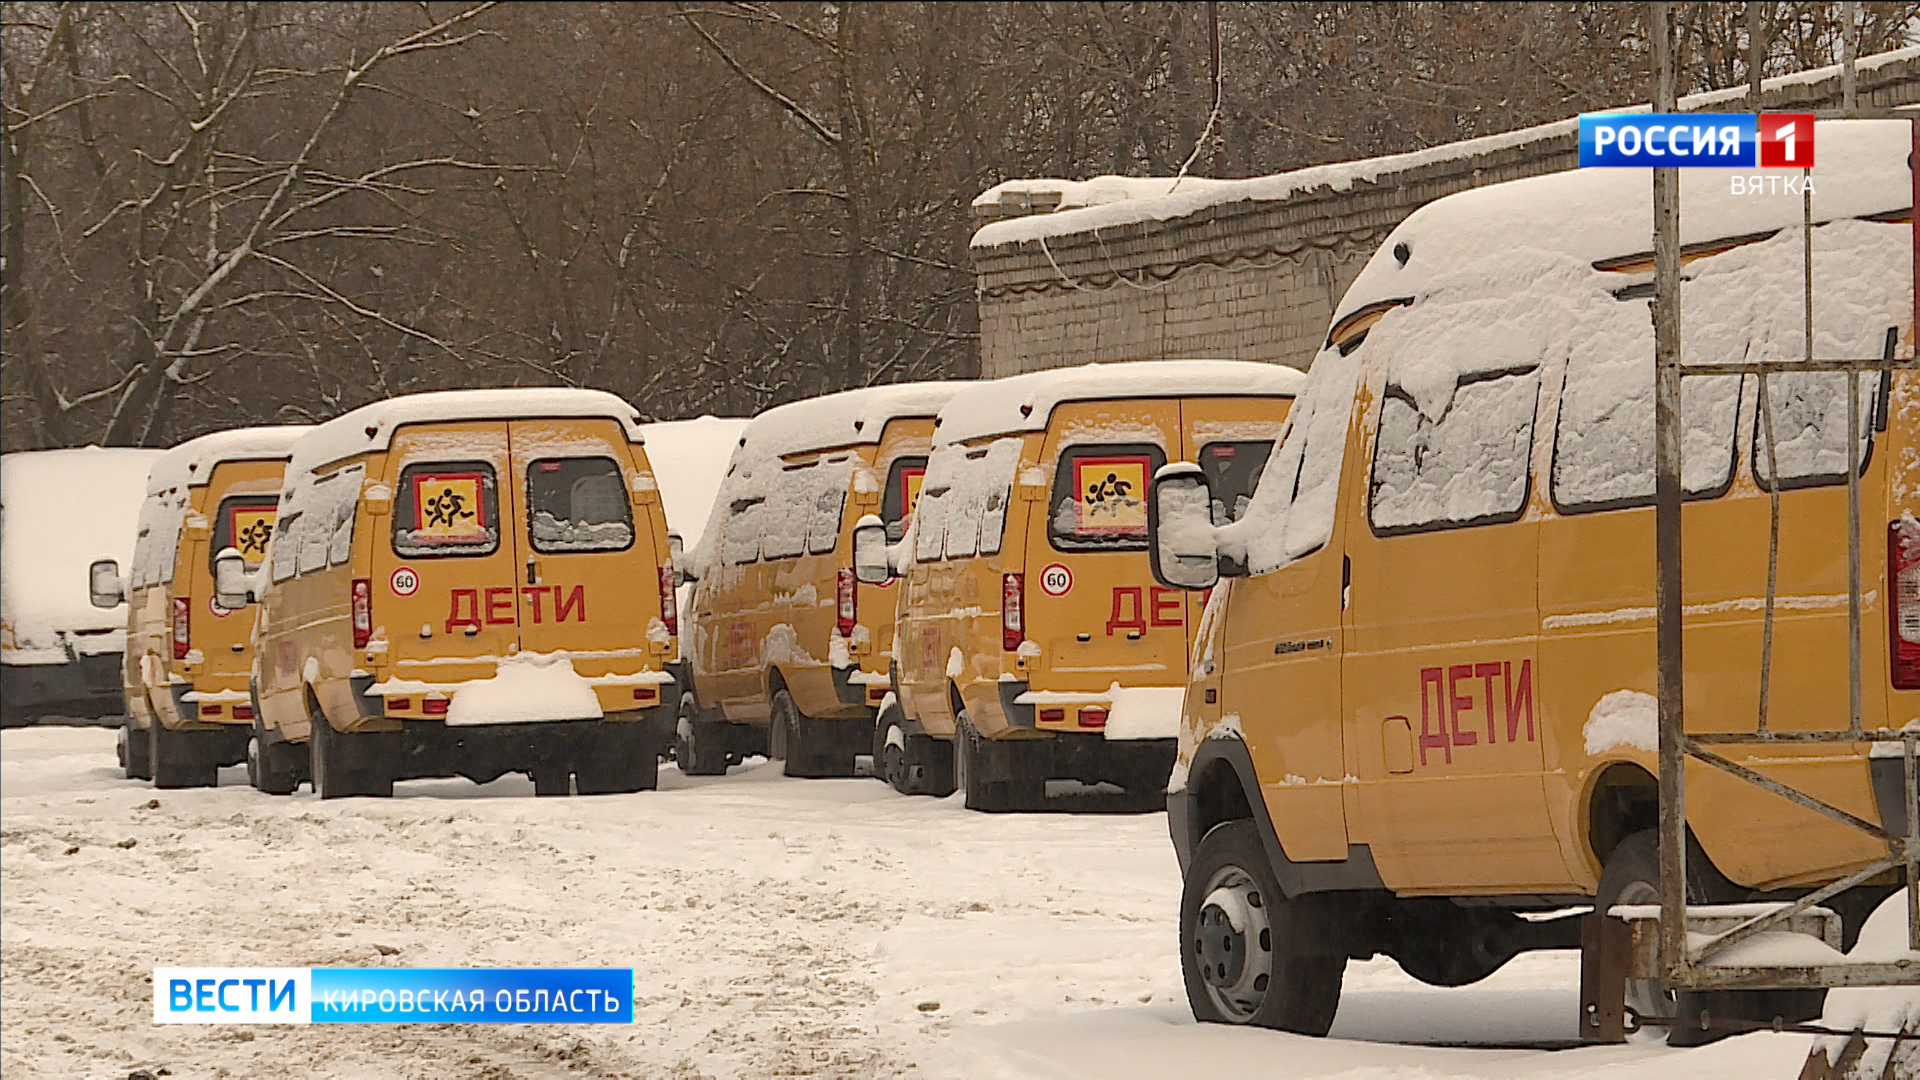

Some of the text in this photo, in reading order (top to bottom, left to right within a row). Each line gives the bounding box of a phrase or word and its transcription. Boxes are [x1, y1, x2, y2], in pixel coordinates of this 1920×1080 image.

[395, 575, 414, 589] 60
[1047, 573, 1066, 588] 60
[445, 585, 586, 634] ДЕТИ
[1418, 659, 1535, 766] ДЕТИ
